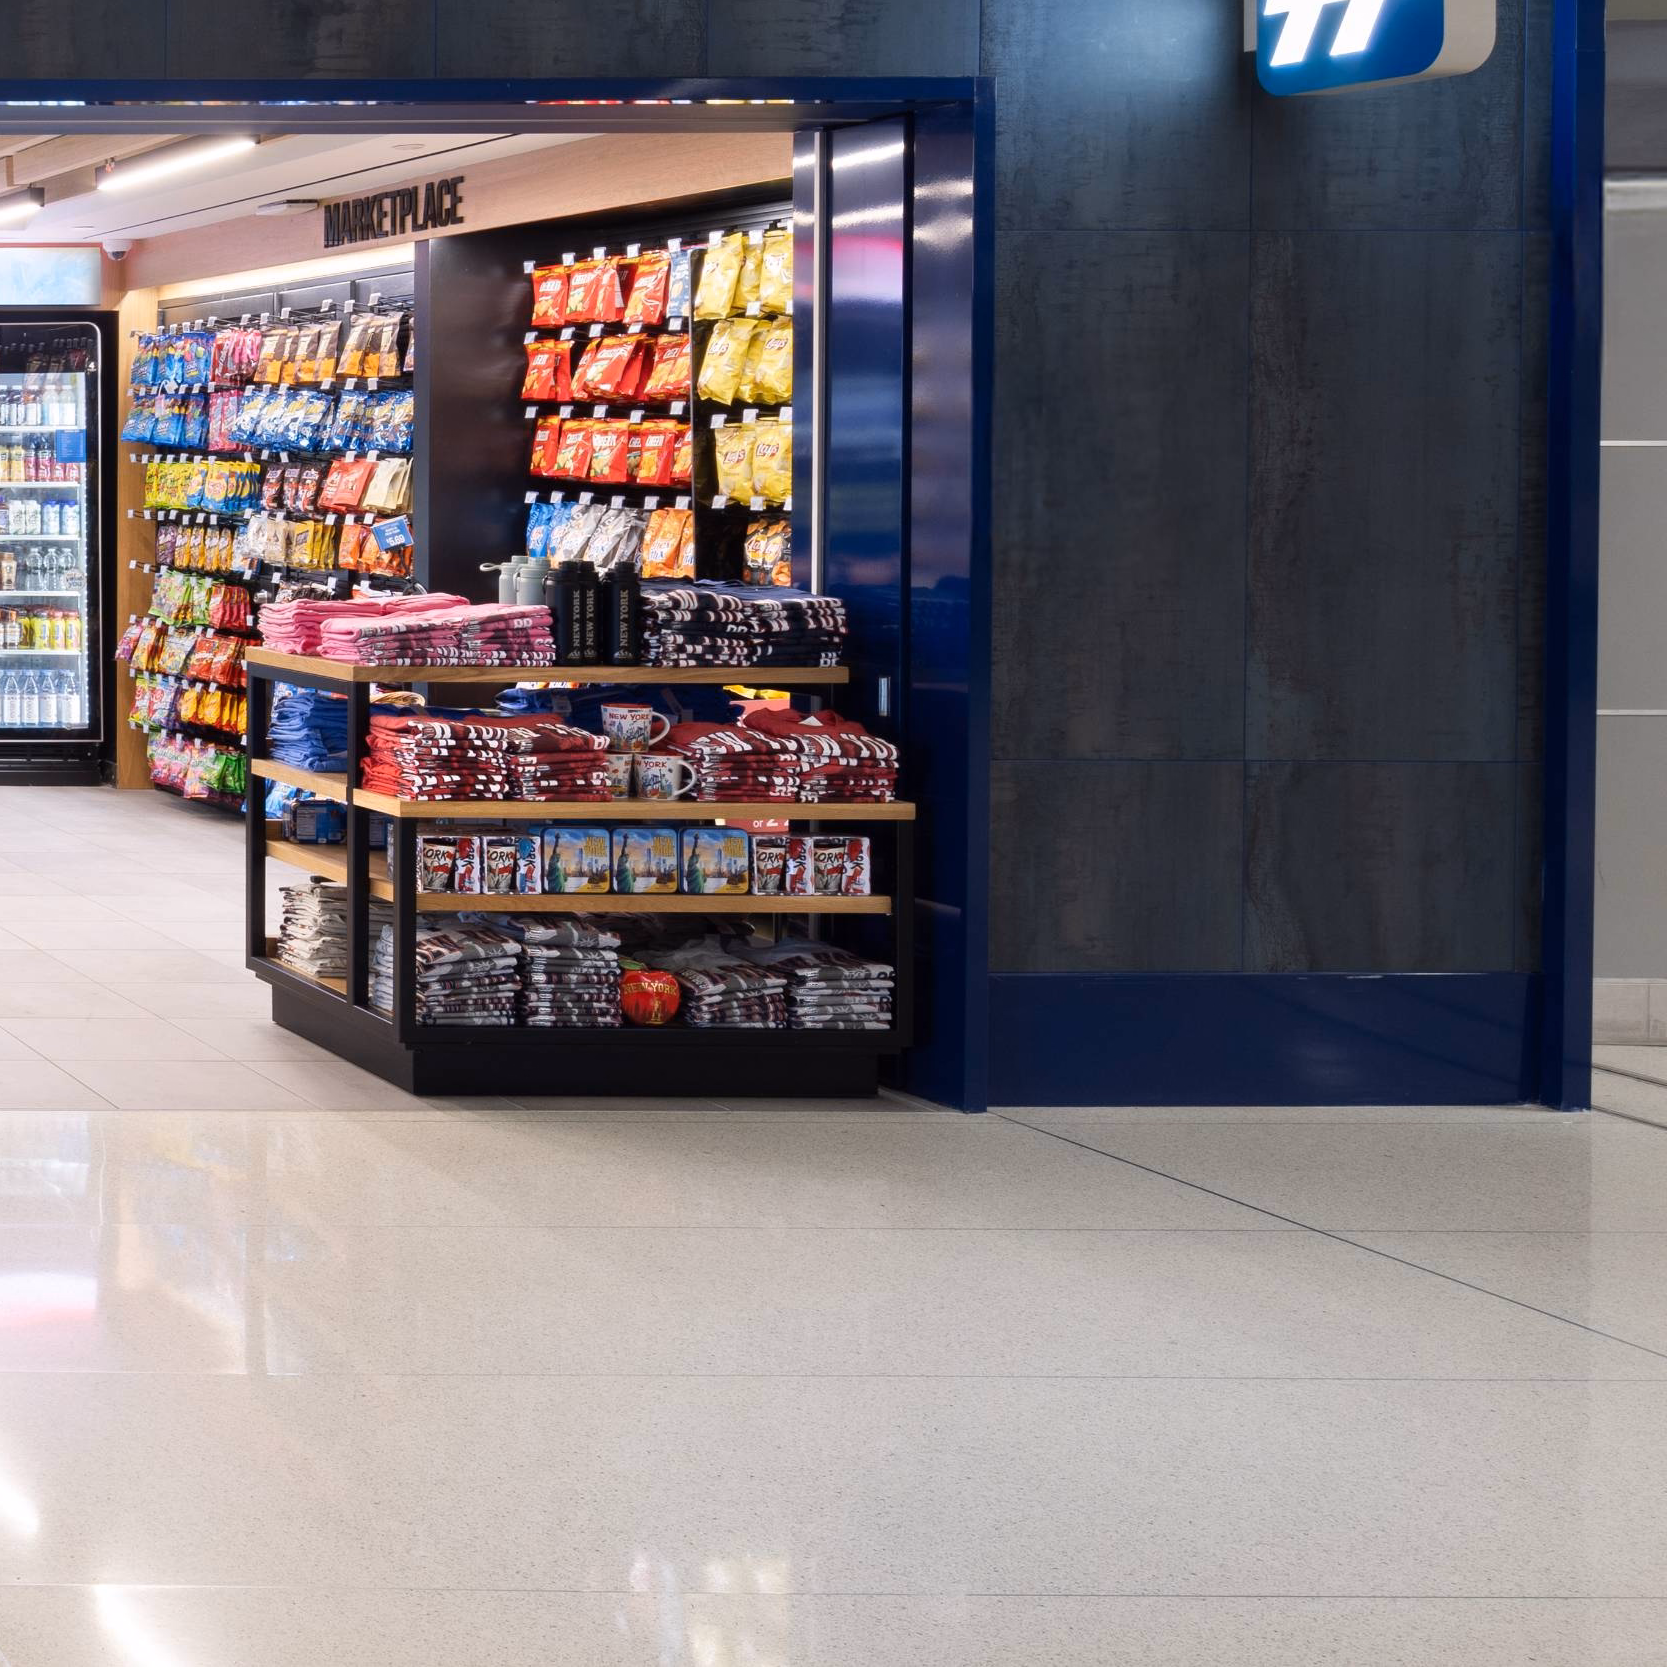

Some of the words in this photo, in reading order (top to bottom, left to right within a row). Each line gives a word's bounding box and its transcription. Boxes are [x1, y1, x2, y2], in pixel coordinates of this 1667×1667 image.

[324, 176, 464, 248] MARKETPLACE
[586, 589, 594, 618] YORK
[620, 590, 628, 619] YORK
[586, 621, 594, 646] NEW
[620, 622, 628, 646] NEW
[753, 820, 763, 828] or
[586, 836, 606, 847] NEW
[653, 836, 673, 846] NEW
[724, 836, 744, 846] NEW
[624, 981, 653, 995] NEW
[651, 980, 677, 995] YORK
